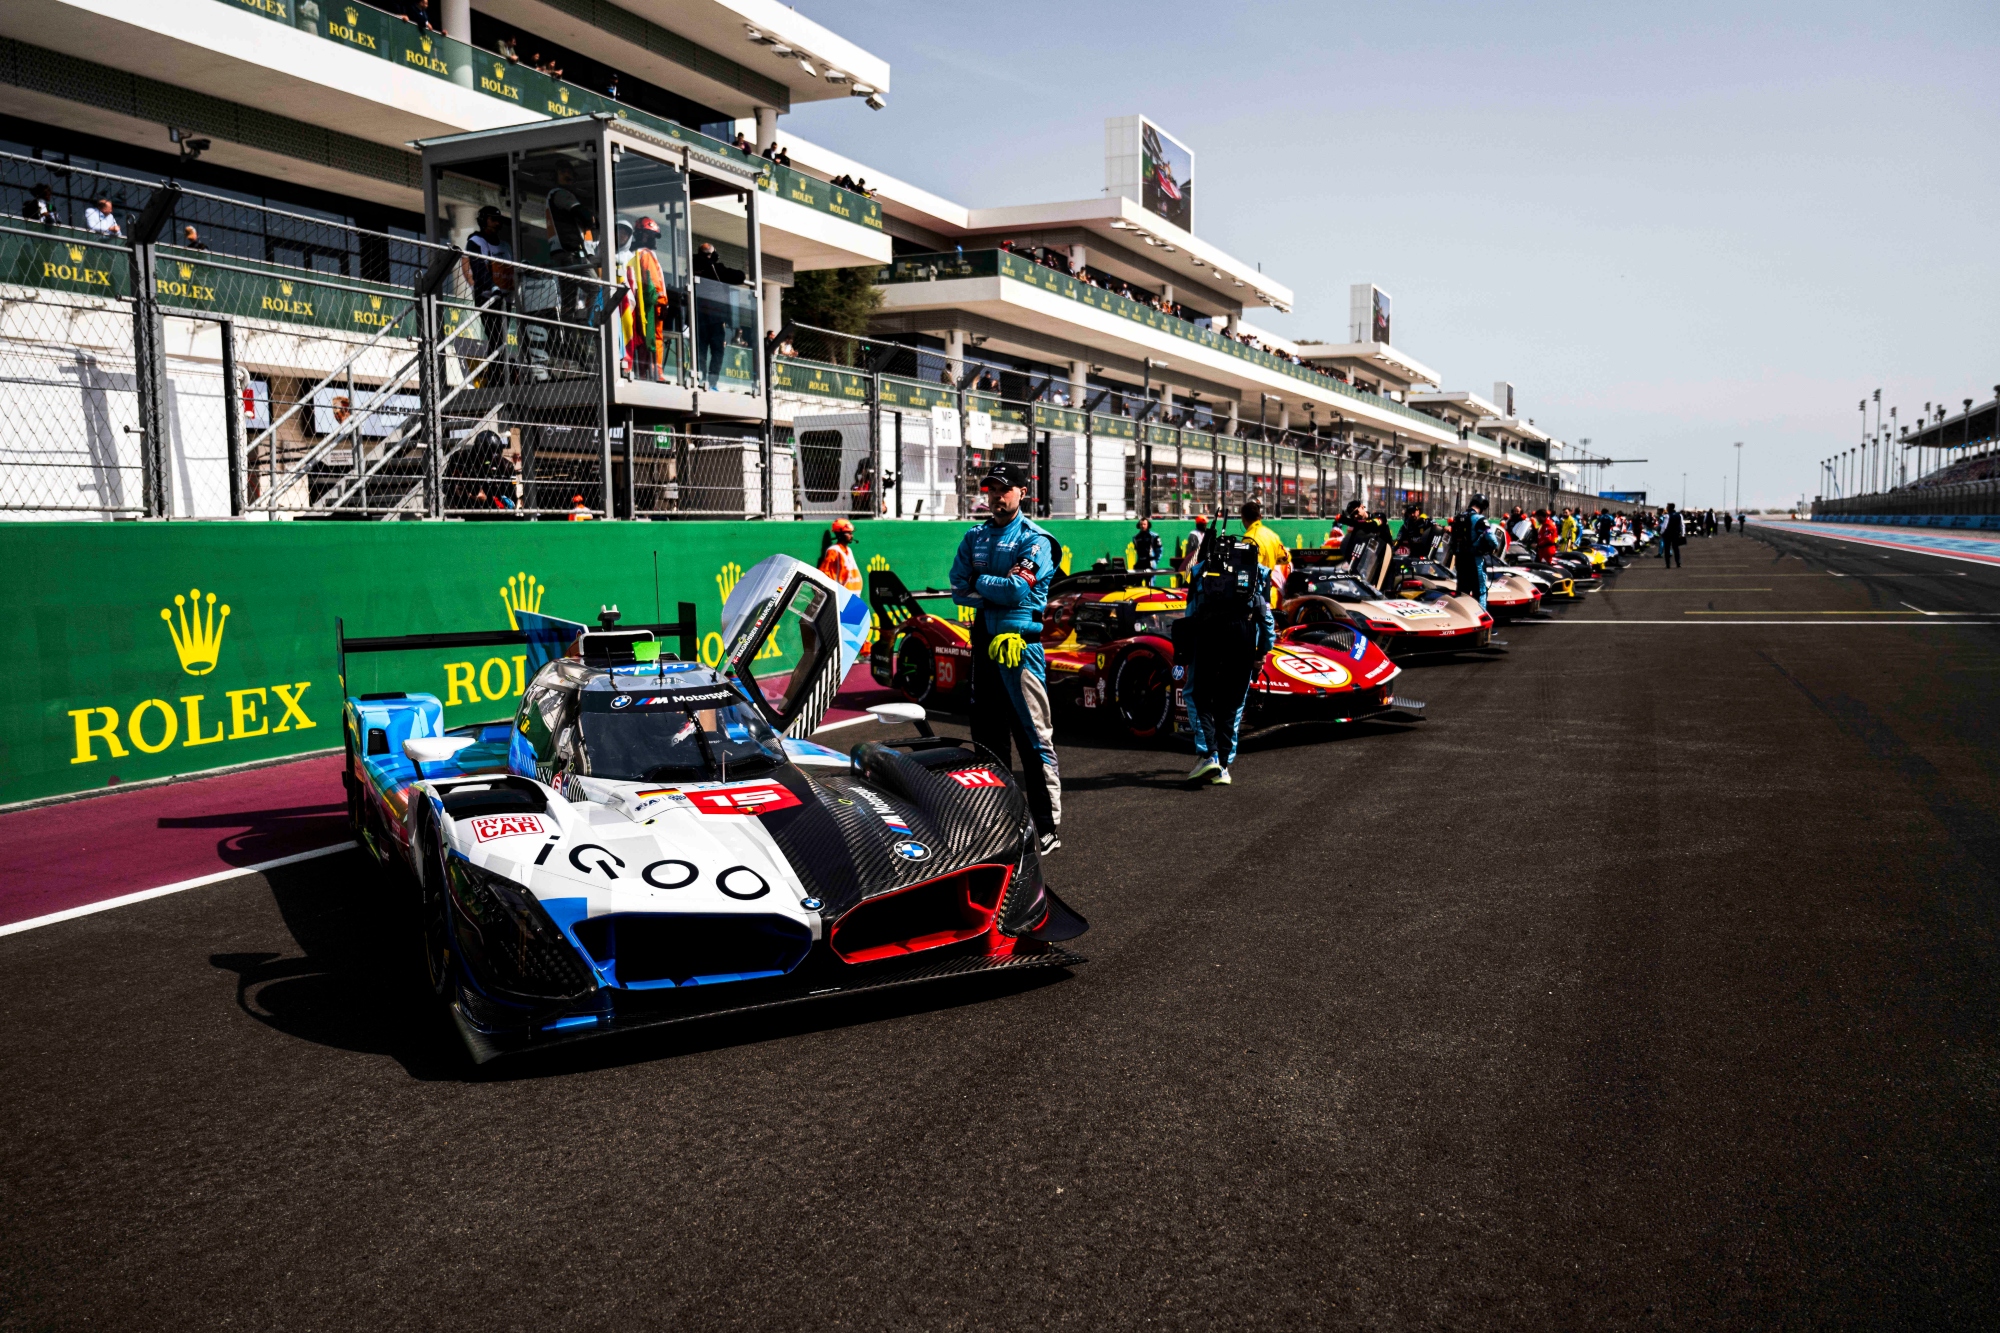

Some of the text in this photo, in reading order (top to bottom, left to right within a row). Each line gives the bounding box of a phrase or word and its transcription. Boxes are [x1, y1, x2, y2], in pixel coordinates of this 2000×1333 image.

[329, 21, 376, 49] ROLEX
[405, 49, 449, 75] ROLEX
[481, 76, 519, 100] ROLEX
[792, 189, 814, 205] ROLEX
[829, 203, 850, 217] ROLEX
[43, 261, 111, 286] ROLEX
[157, 279, 216, 301] ROLEX
[262, 295, 314, 316] ROLEX
[725, 368, 750, 379] ROLEX
[808, 381, 829, 392] ROLEX
[1059, 477, 1069, 492] 5
[760, 593, 779, 621] MARCIELLO
[736, 626, 759, 657] MAGNUSSEN
[935, 646, 959, 656] RICHARD
[939, 662, 953, 683] 50
[1173, 665, 1184, 680] hp
[1287, 657, 1331, 674] 50
[444, 655, 527, 706] ROL
[672, 689, 733, 703] Motorsport
[68, 682, 316, 764] ROLEX
[952, 771, 997, 787] HY
[634, 798, 660, 812] FIA
[702, 789, 782, 806] 15
[477, 816, 534, 829] HYPER
[480, 821, 539, 841] CAR
